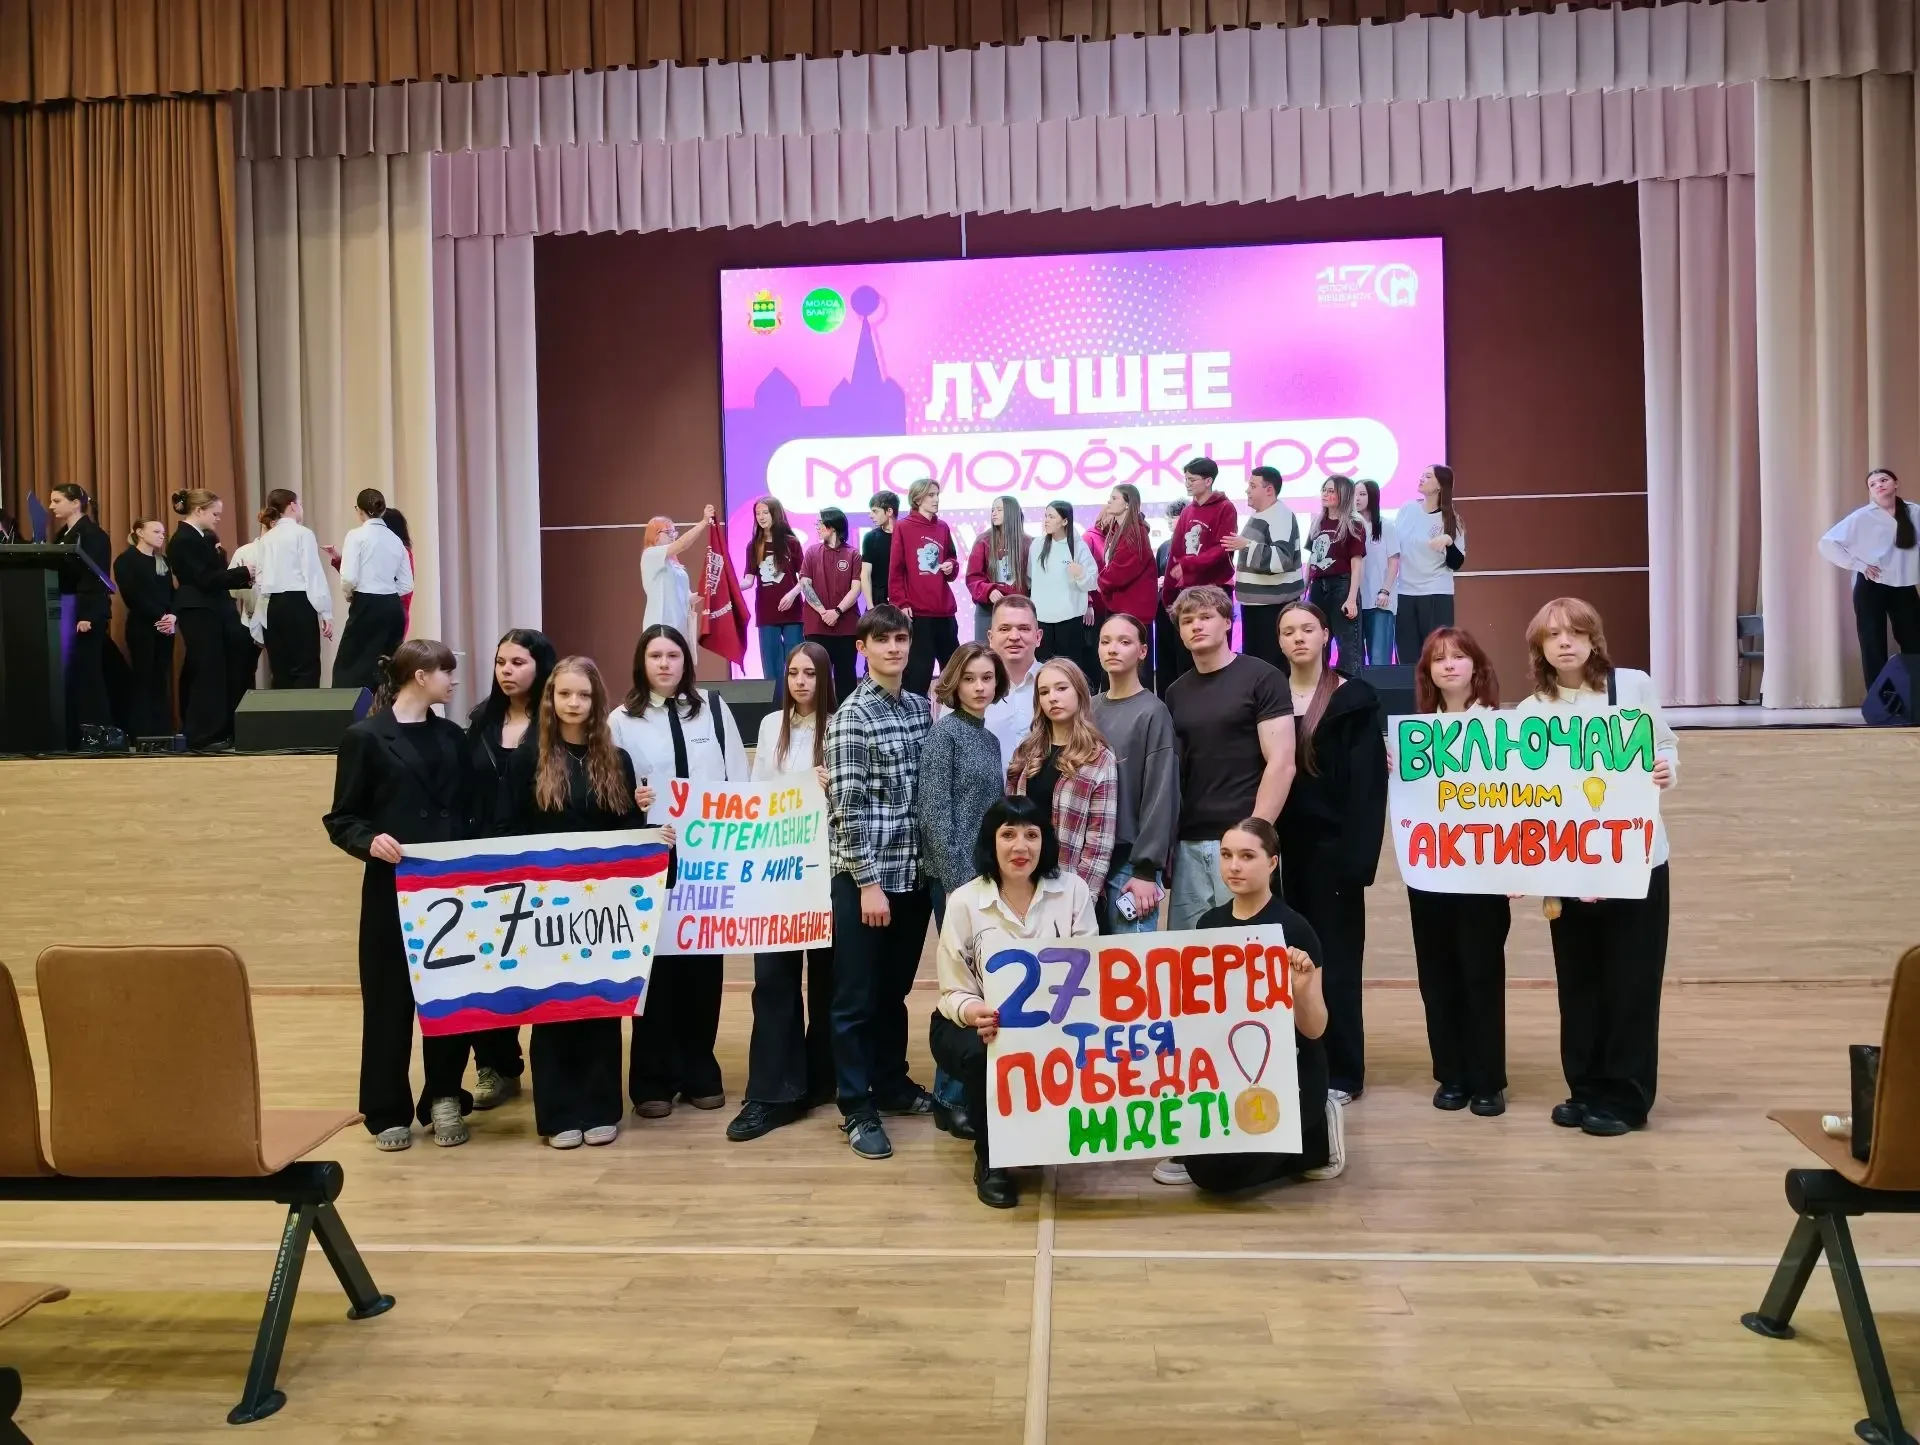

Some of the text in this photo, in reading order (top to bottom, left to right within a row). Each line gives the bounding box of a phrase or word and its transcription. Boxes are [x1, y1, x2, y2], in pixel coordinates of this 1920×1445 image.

[924, 351, 1233, 421] ЛУЧШЕЕ
[1398, 708, 1655, 782] ВКЛЮЧАЙ
[668, 780, 803, 820] У НАС ЕСТЬ
[685, 810, 821, 851] СТРЕМЛЕНИЕ!
[740, 859, 754, 883] В
[667, 883, 736, 912] НАШЕ
[422, 882, 534, 970] 27
[677, 910, 832, 950] САМОУПРАВЛЕНИЕ!
[985, 936, 1294, 1029] 27 ВПЕРЁД
[1062, 1020, 1177, 1070] ТЕБЯ
[996, 1047, 1220, 1117] ПОБЕДА
[1068, 1091, 1231, 1157] ЖДЁТ!
[1247, 1095, 1267, 1121] 1
